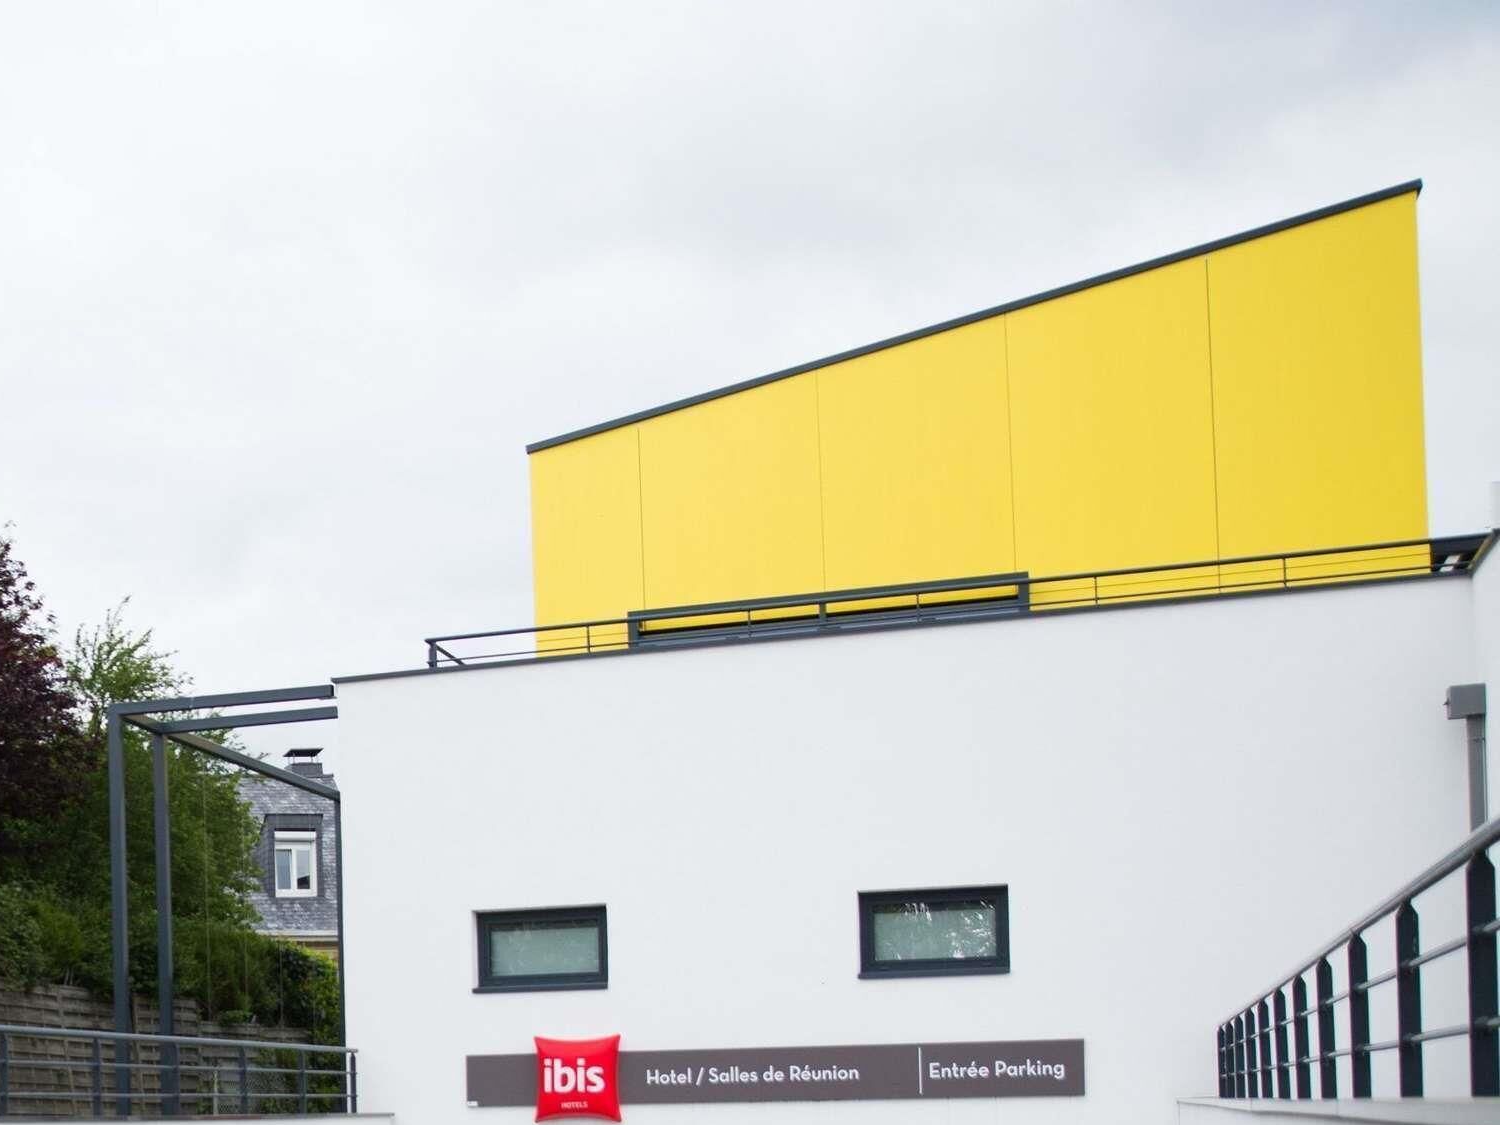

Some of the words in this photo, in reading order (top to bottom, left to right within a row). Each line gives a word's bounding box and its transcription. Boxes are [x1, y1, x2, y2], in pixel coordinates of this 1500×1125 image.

[543, 1057, 606, 1094] ibis
[646, 1067, 692, 1085] Hotel
[708, 1066, 758, 1083] Salles
[762, 1065, 785, 1082] de
[789, 1065, 860, 1082] Réunion
[929, 1061, 989, 1079] Entrée
[994, 1059, 1066, 1080] Parking
[561, 1101, 589, 1109] HOTELS
